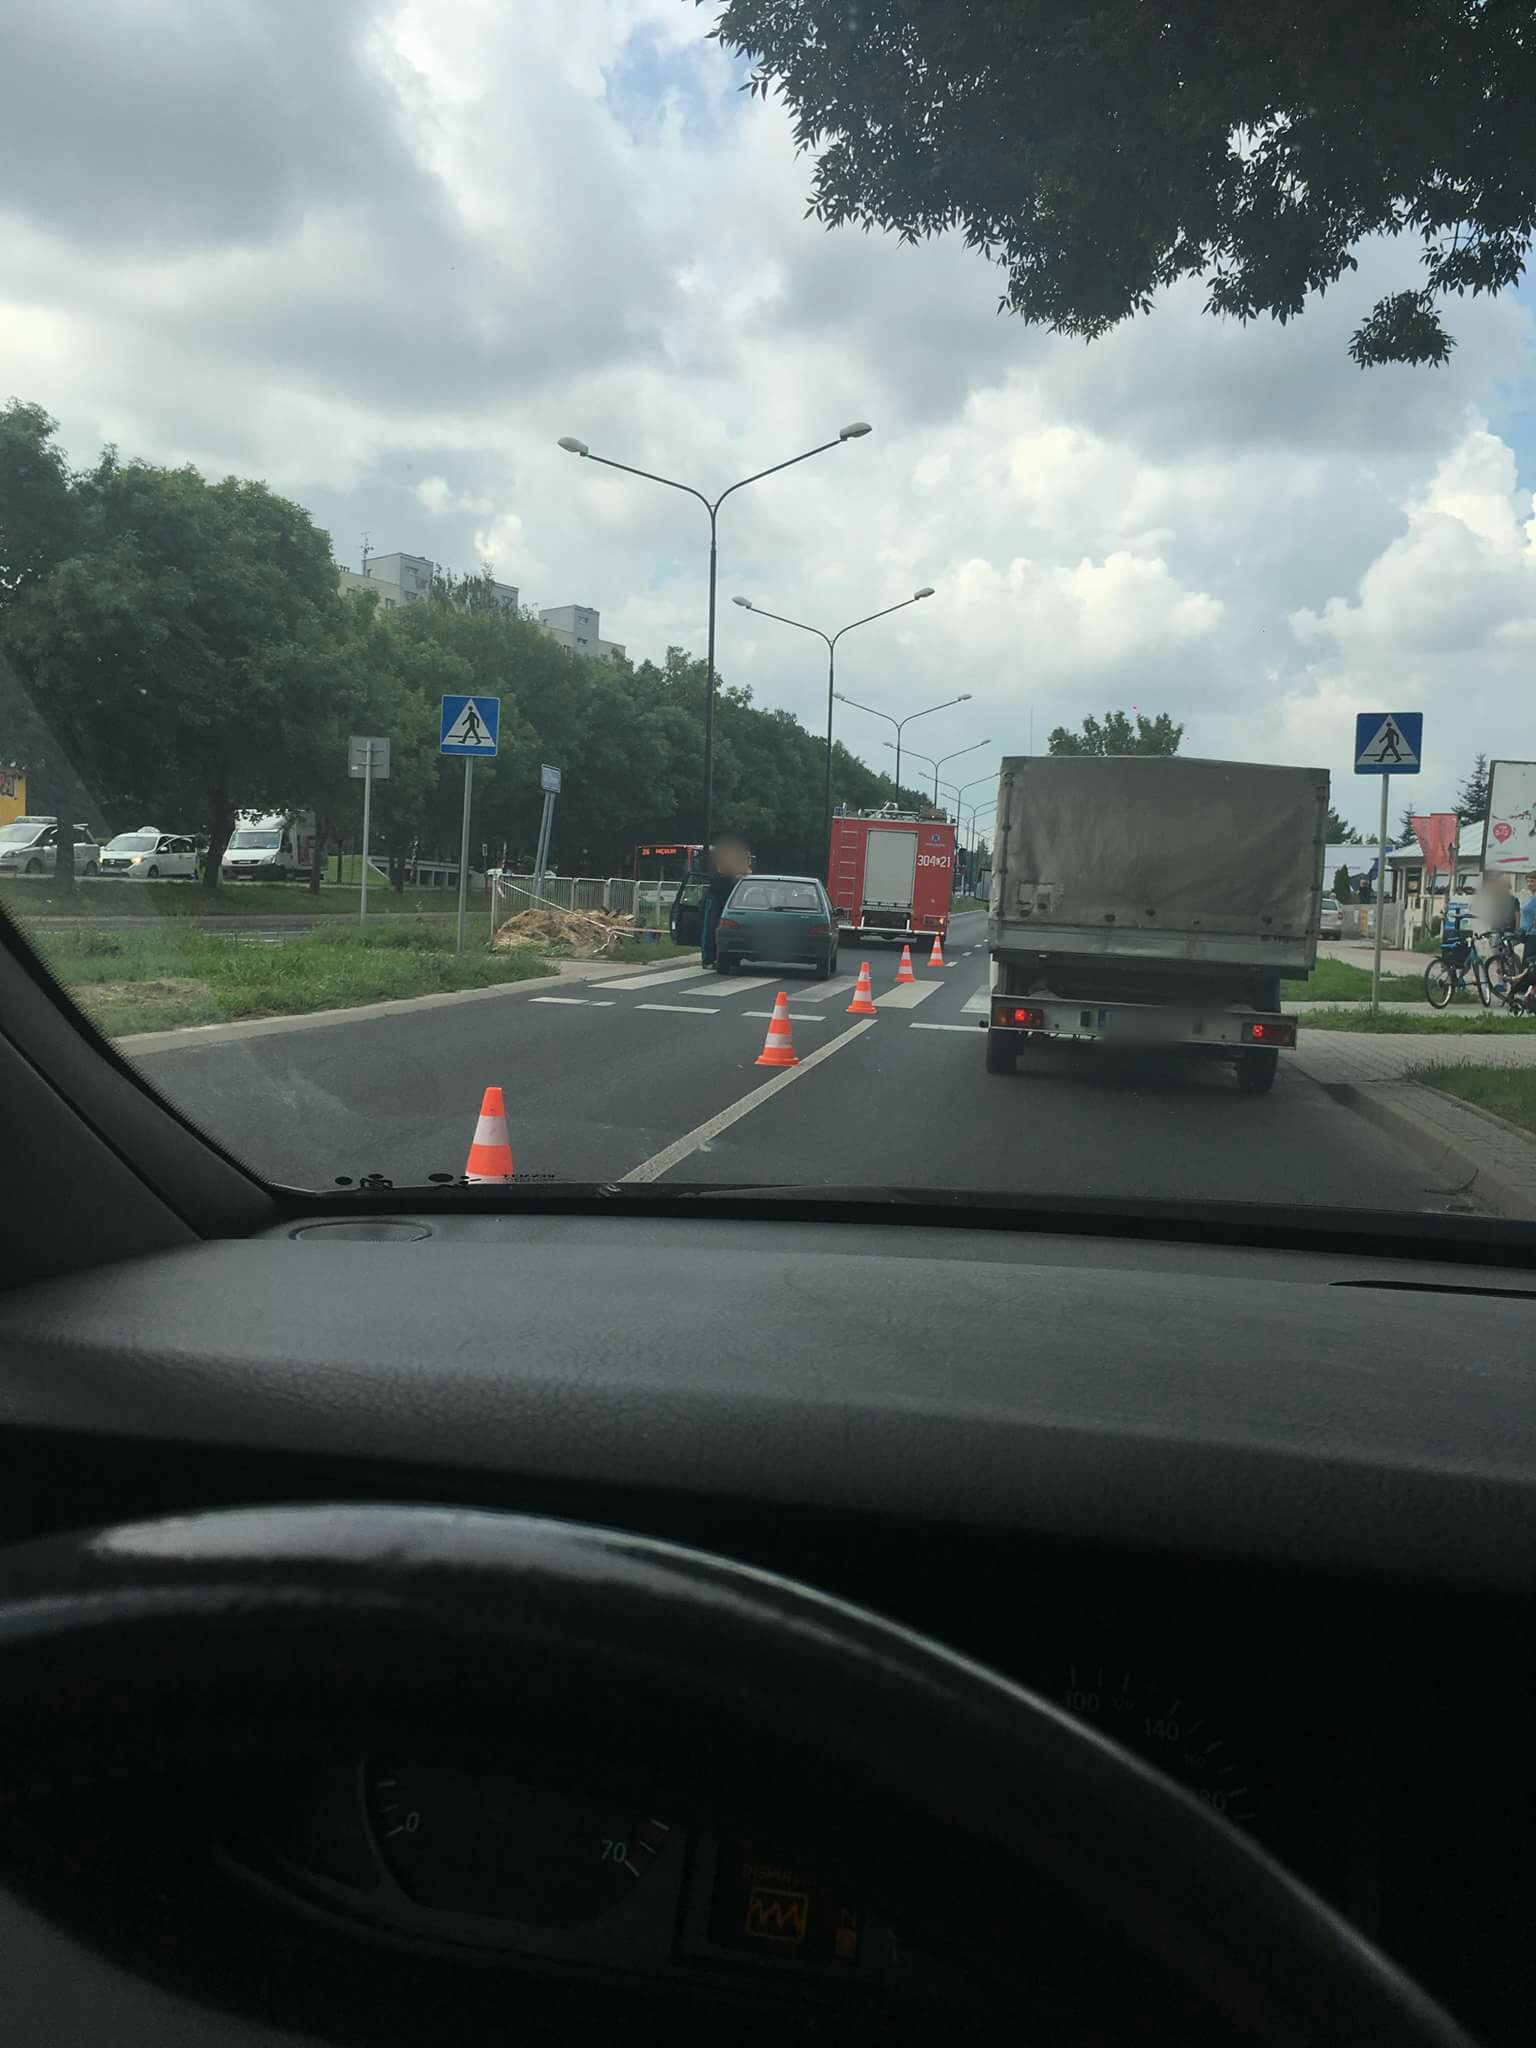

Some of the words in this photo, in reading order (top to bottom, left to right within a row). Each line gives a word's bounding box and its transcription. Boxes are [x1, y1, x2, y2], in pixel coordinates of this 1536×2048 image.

[1145, 1715, 1182, 1742] 140
[405, 1811, 419, 1832] 0
[601, 1839, 627, 1864] 70
